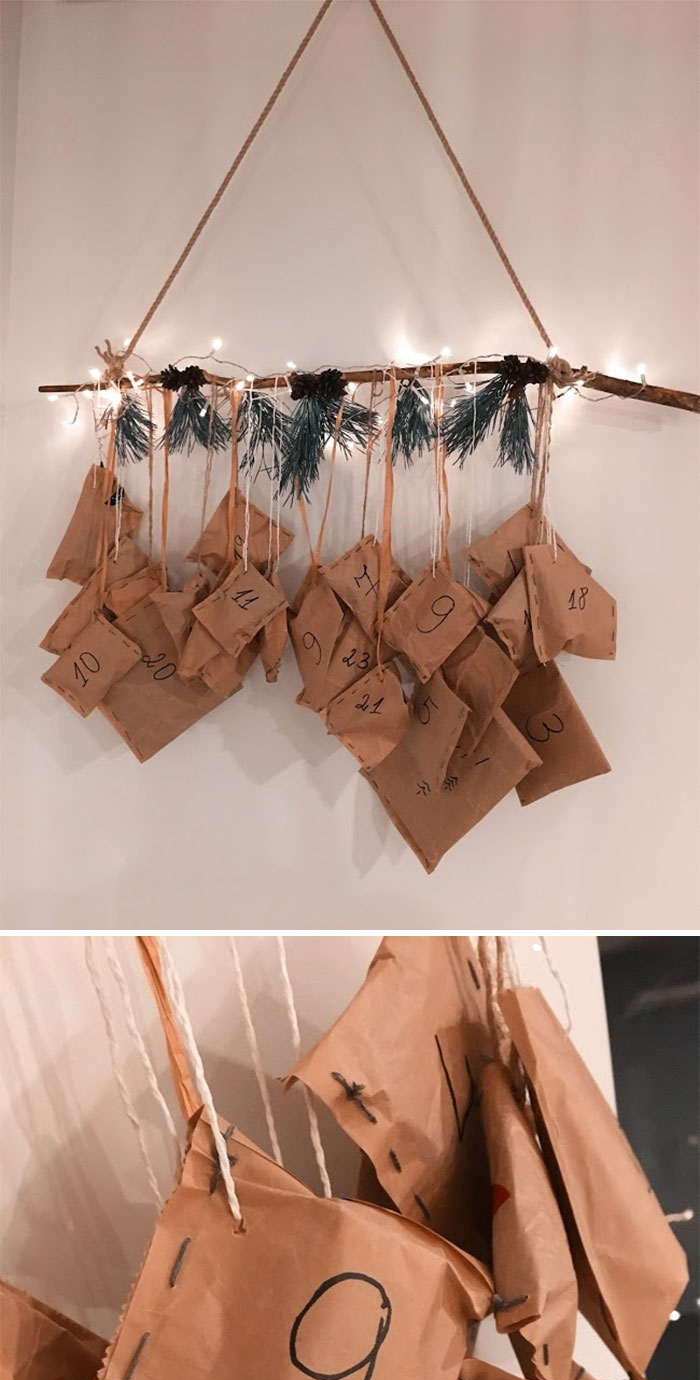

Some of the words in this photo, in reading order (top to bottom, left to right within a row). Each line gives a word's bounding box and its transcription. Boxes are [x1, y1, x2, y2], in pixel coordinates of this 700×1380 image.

[354, 564, 379, 598] 7
[231, 589, 259, 611] 11
[568, 587, 589, 610] 18
[416, 595, 456, 634] 9
[74, 652, 100, 688] 10
[141, 653, 177, 681] 20
[342, 649, 371, 669] 23
[355, 694, 384, 715] 21
[418, 696, 439, 725] 5
[525, 713, 564, 743] 3
